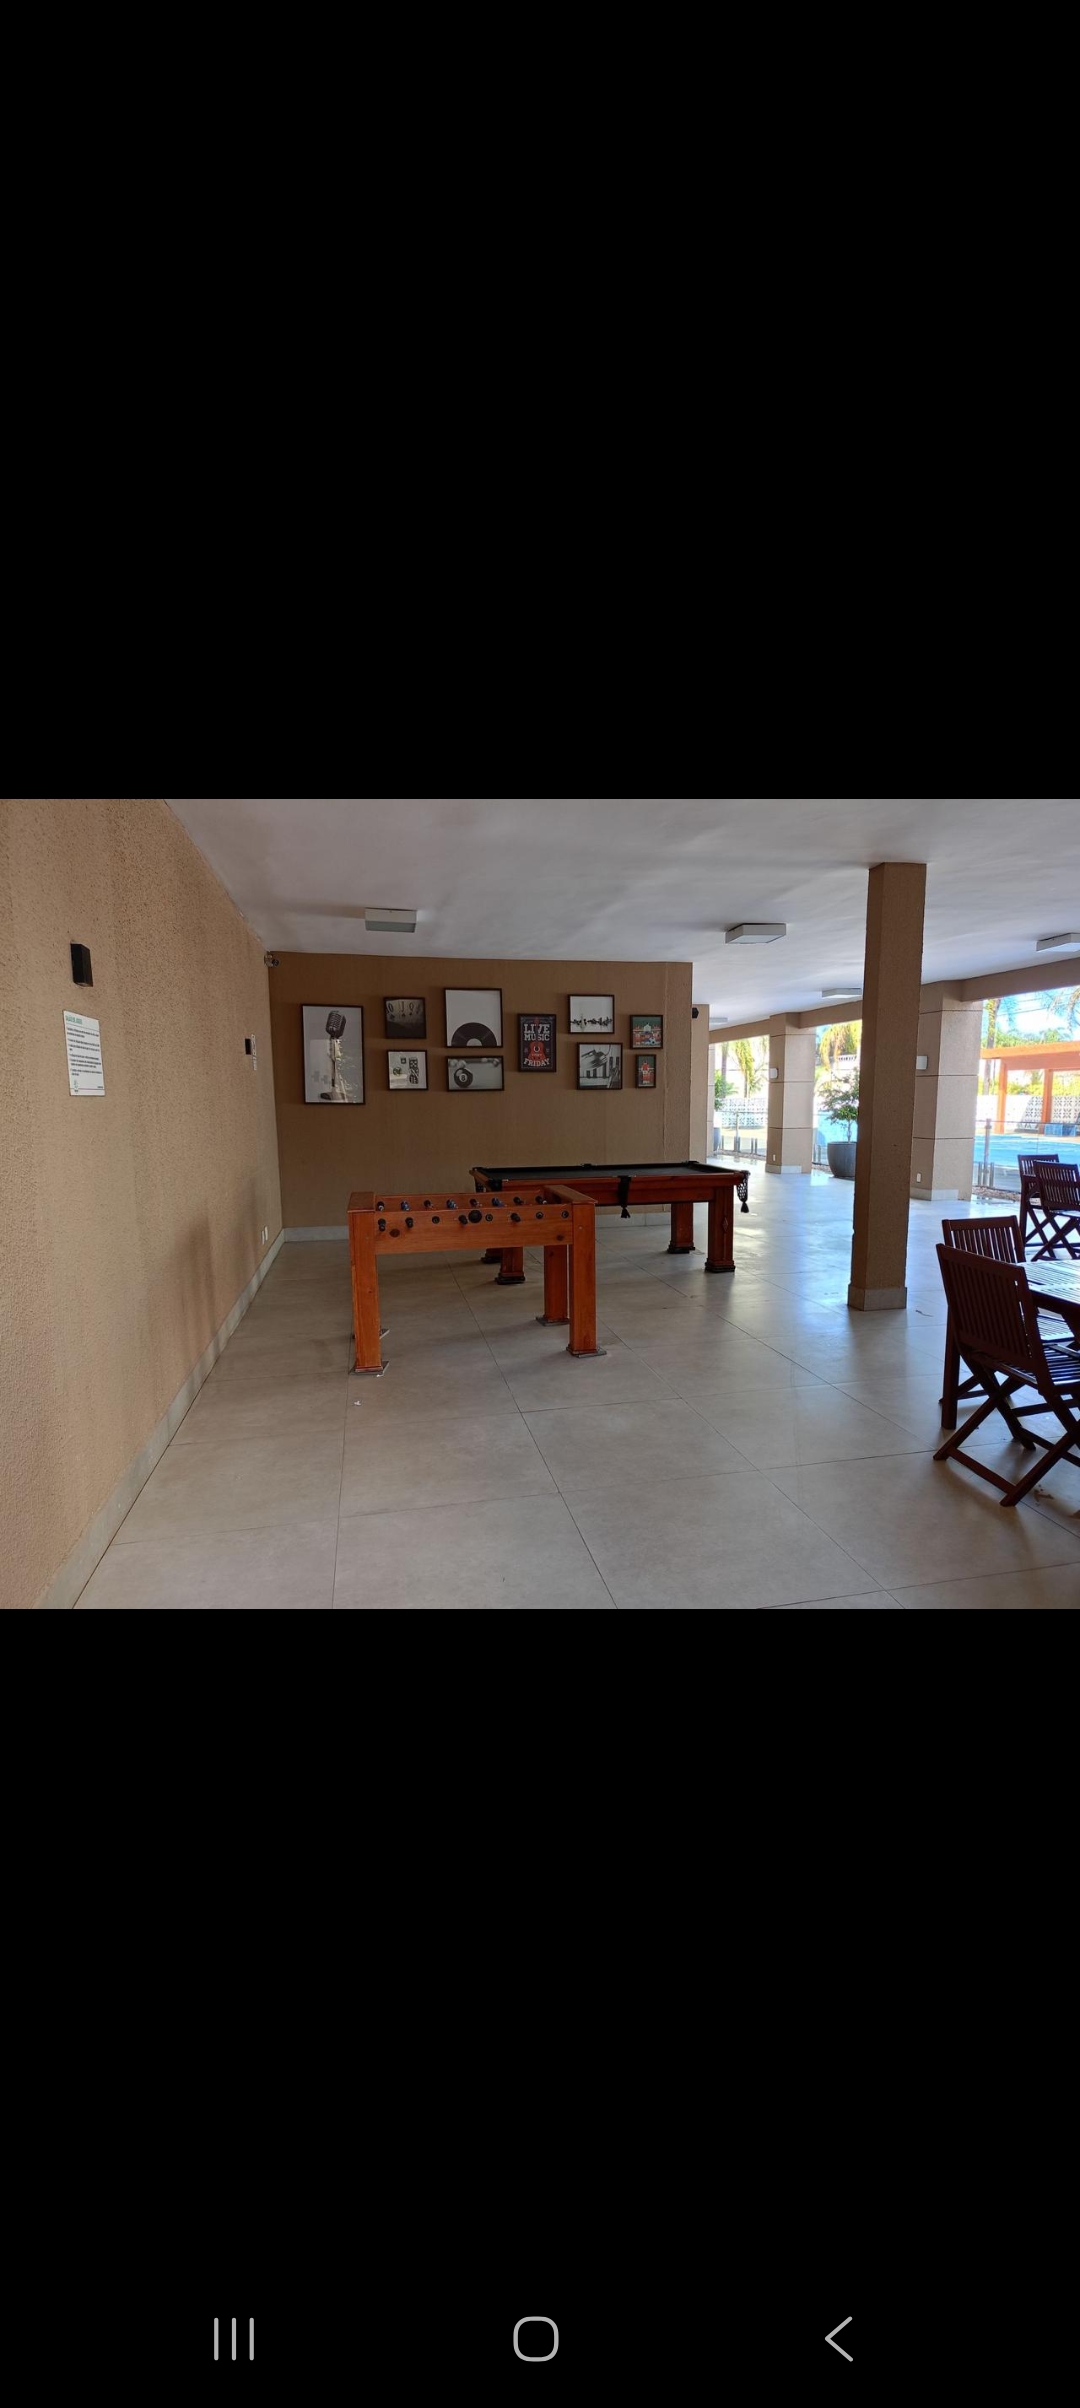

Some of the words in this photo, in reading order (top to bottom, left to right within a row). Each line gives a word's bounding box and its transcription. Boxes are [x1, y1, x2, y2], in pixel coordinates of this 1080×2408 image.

[524, 1024, 550, 1034] LIVE
[524, 1033, 550, 1041] MUSIC
[524, 1058, 550, 1067] FRIDAY
